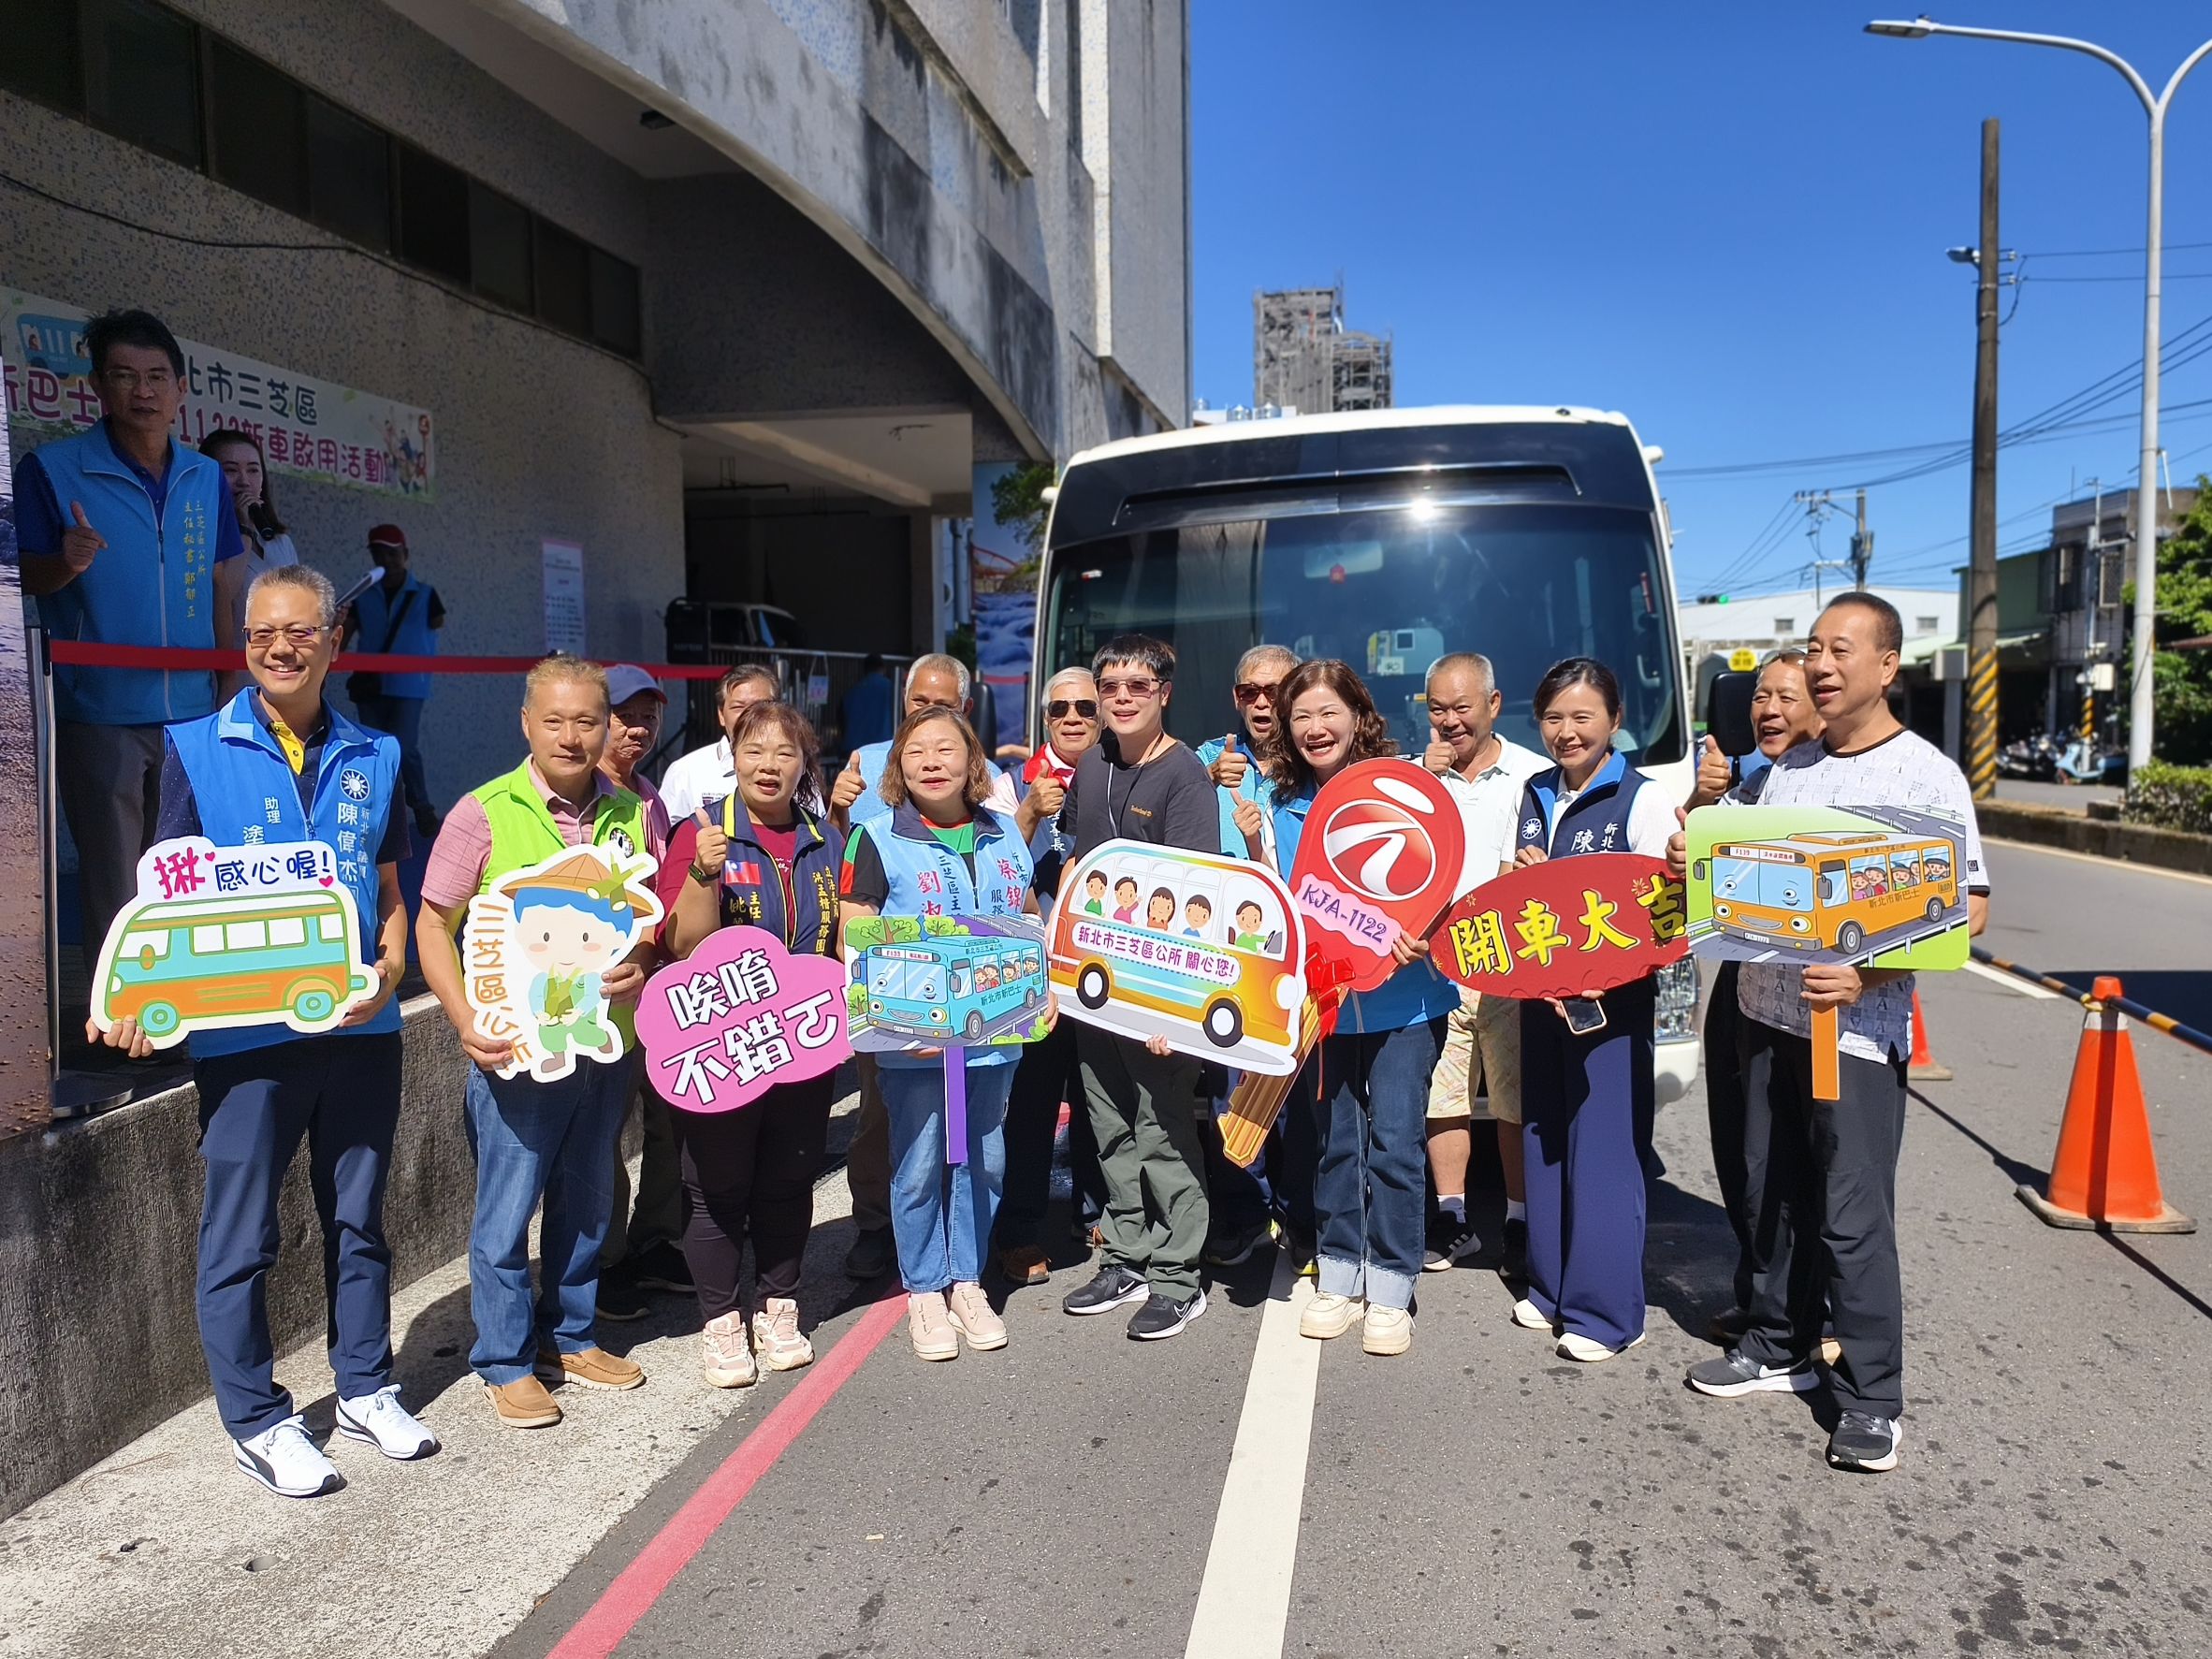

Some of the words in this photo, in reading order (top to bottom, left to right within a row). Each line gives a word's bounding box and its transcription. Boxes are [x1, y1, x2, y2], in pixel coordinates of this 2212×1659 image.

[242, 824, 266, 845] 塗
[264, 796, 282, 824] 助理
[337, 802, 358, 882] 陳偉杰
[1570, 829, 1595, 853] 陳
[1600, 822, 1619, 851] 新北
[749, 891, 762, 919] 主任
[938, 855, 961, 915] 三芝區主
[991, 889, 1005, 915] 服務
[997, 858, 1022, 908] 蔡錦
[1869, 888, 1920, 909] 新北市新巴士
[812, 872, 831, 955] 洪孟楷服務團
[1302, 883, 1387, 943] KJA-1122
[1448, 871, 1686, 978] 開車大吉
[1078, 925, 1183, 967] 新北市三芝區公所
[1185, 951, 1235, 978] 關心您!
[664, 948, 779, 1031] 唉唷
[981, 984, 1022, 1006] 新北市新巴士
[661, 984, 848, 1105] 不錯ㄛ
